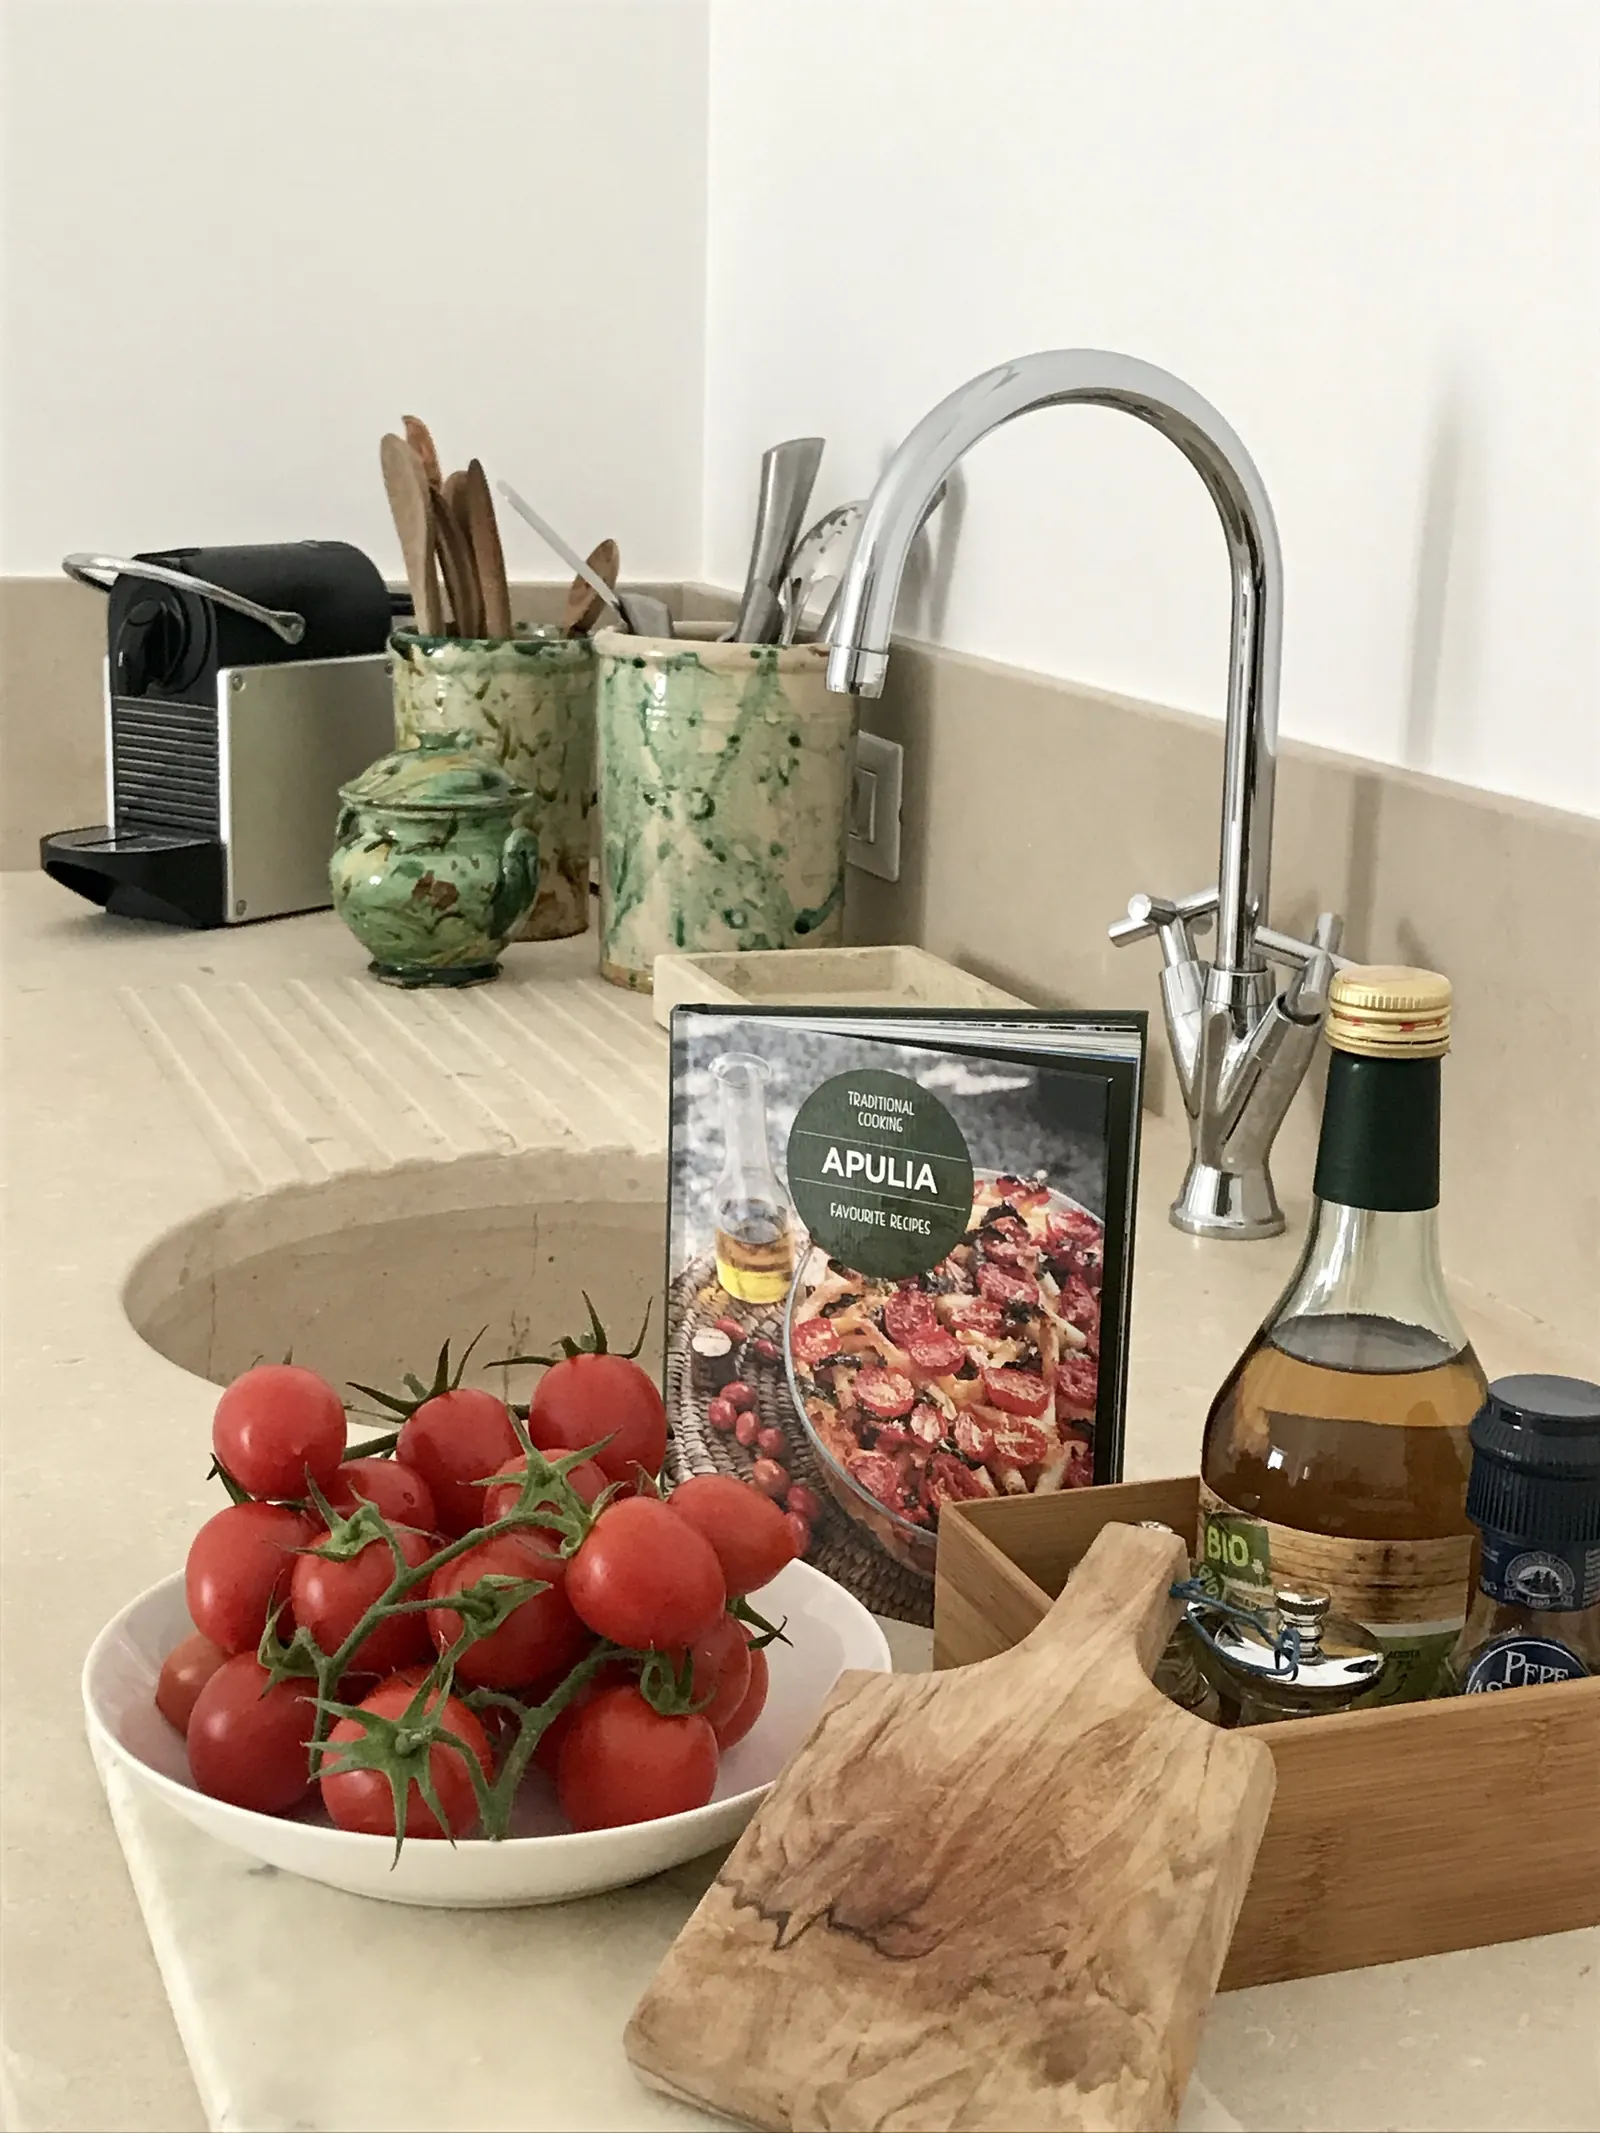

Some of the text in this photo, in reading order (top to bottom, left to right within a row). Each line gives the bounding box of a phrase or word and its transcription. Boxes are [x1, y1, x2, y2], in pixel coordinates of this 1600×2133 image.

[848, 1090, 915, 1116] TRADITIONAL
[857, 1111, 903, 1133] COOKING
[821, 1146, 938, 1194] APULIA
[830, 1202, 931, 1235] FAVOURITE RECIPES
[1207, 1525, 1249, 1567] BIO
